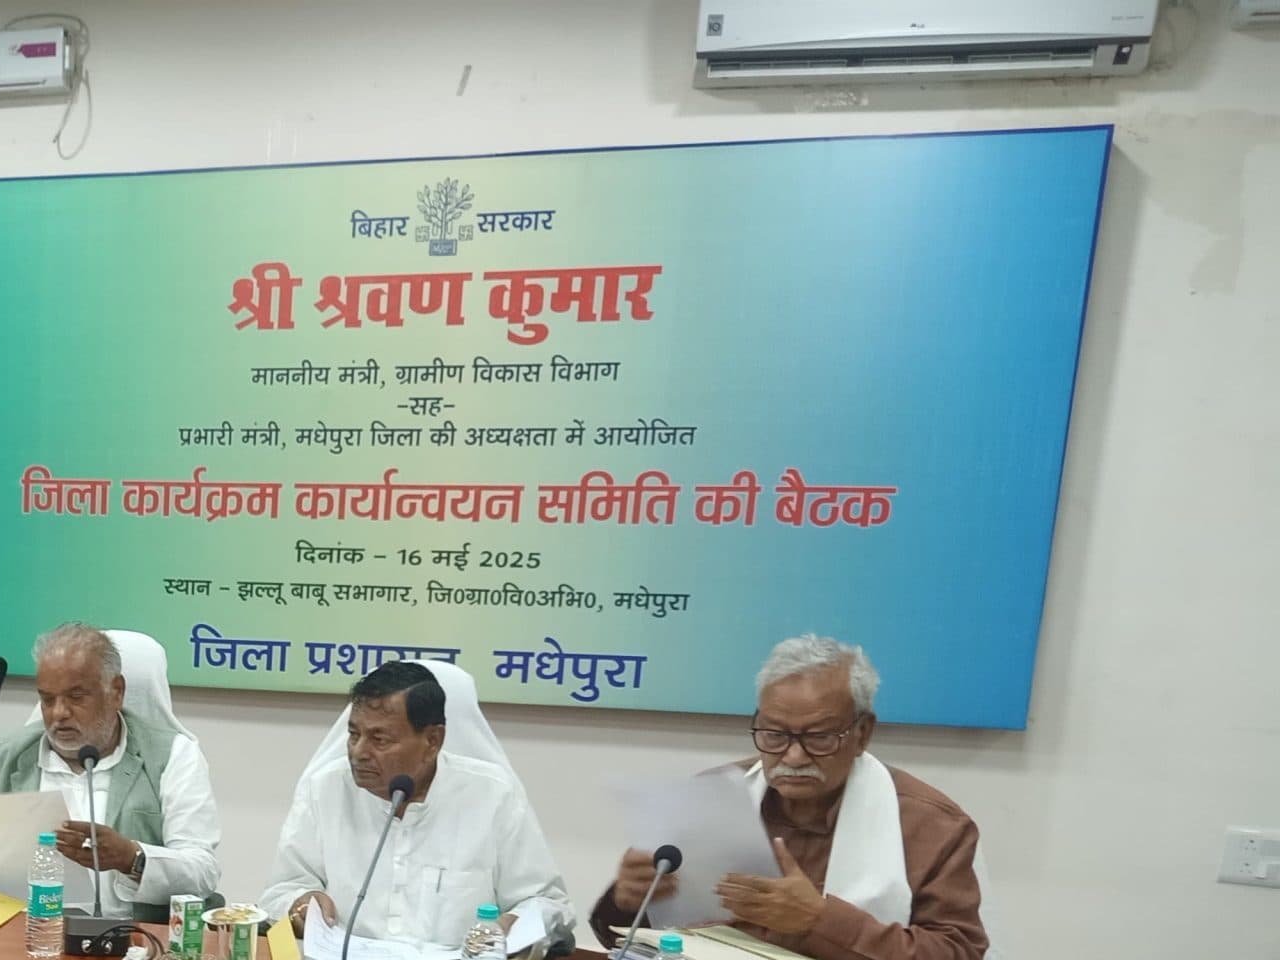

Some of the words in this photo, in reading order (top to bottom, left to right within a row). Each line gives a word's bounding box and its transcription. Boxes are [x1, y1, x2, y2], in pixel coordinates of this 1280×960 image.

[350, 209, 410, 240] बिहार
[476, 210, 556, 233] सरकार
[227, 262, 303, 331] श्री
[313, 271, 473, 329] श्रवण
[483, 265, 663, 346] कुमार
[250, 359, 332, 386] माननीय
[337, 358, 386, 389] मंत्री,
[394, 357, 465, 385] ग्रामीण
[471, 356, 543, 383] विकास
[550, 354, 621, 382] विभाग
[178, 420, 234, 446] प्रभारी
[240, 420, 286, 449] मंत्री,
[295, 420, 363, 455] मधेपुरा
[369, 420, 423, 447] जिला
[429, 420, 458, 447] की
[464, 427, 558, 447] अध्यक्षता
[564, 419, 586, 446] में
[593, 418, 698, 446] आयोजित
[21, 466, 111, 515] जिला
[122, 466, 283, 523] कार्यक्रम
[294, 468, 525, 523] कार्यान्वयन
[538, 470, 681, 525] समिति
[695, 470, 762, 526] की
[295, 539, 366, 564] दिनांक
[397, 549, 422, 566] 16
[431, 542, 471, 572] मई
[479, 550, 541, 569] 2025
[163, 578, 213, 596] स्थान
[236, 581, 288, 606] झल्लू
[289, 582, 330, 607] बाबू
[332, 584, 418, 606] सभागार,
[613, 585, 691, 619] मधेपुरा
[189, 623, 292, 672] जिला
[492, 636, 648, 702] मधेपुरा
